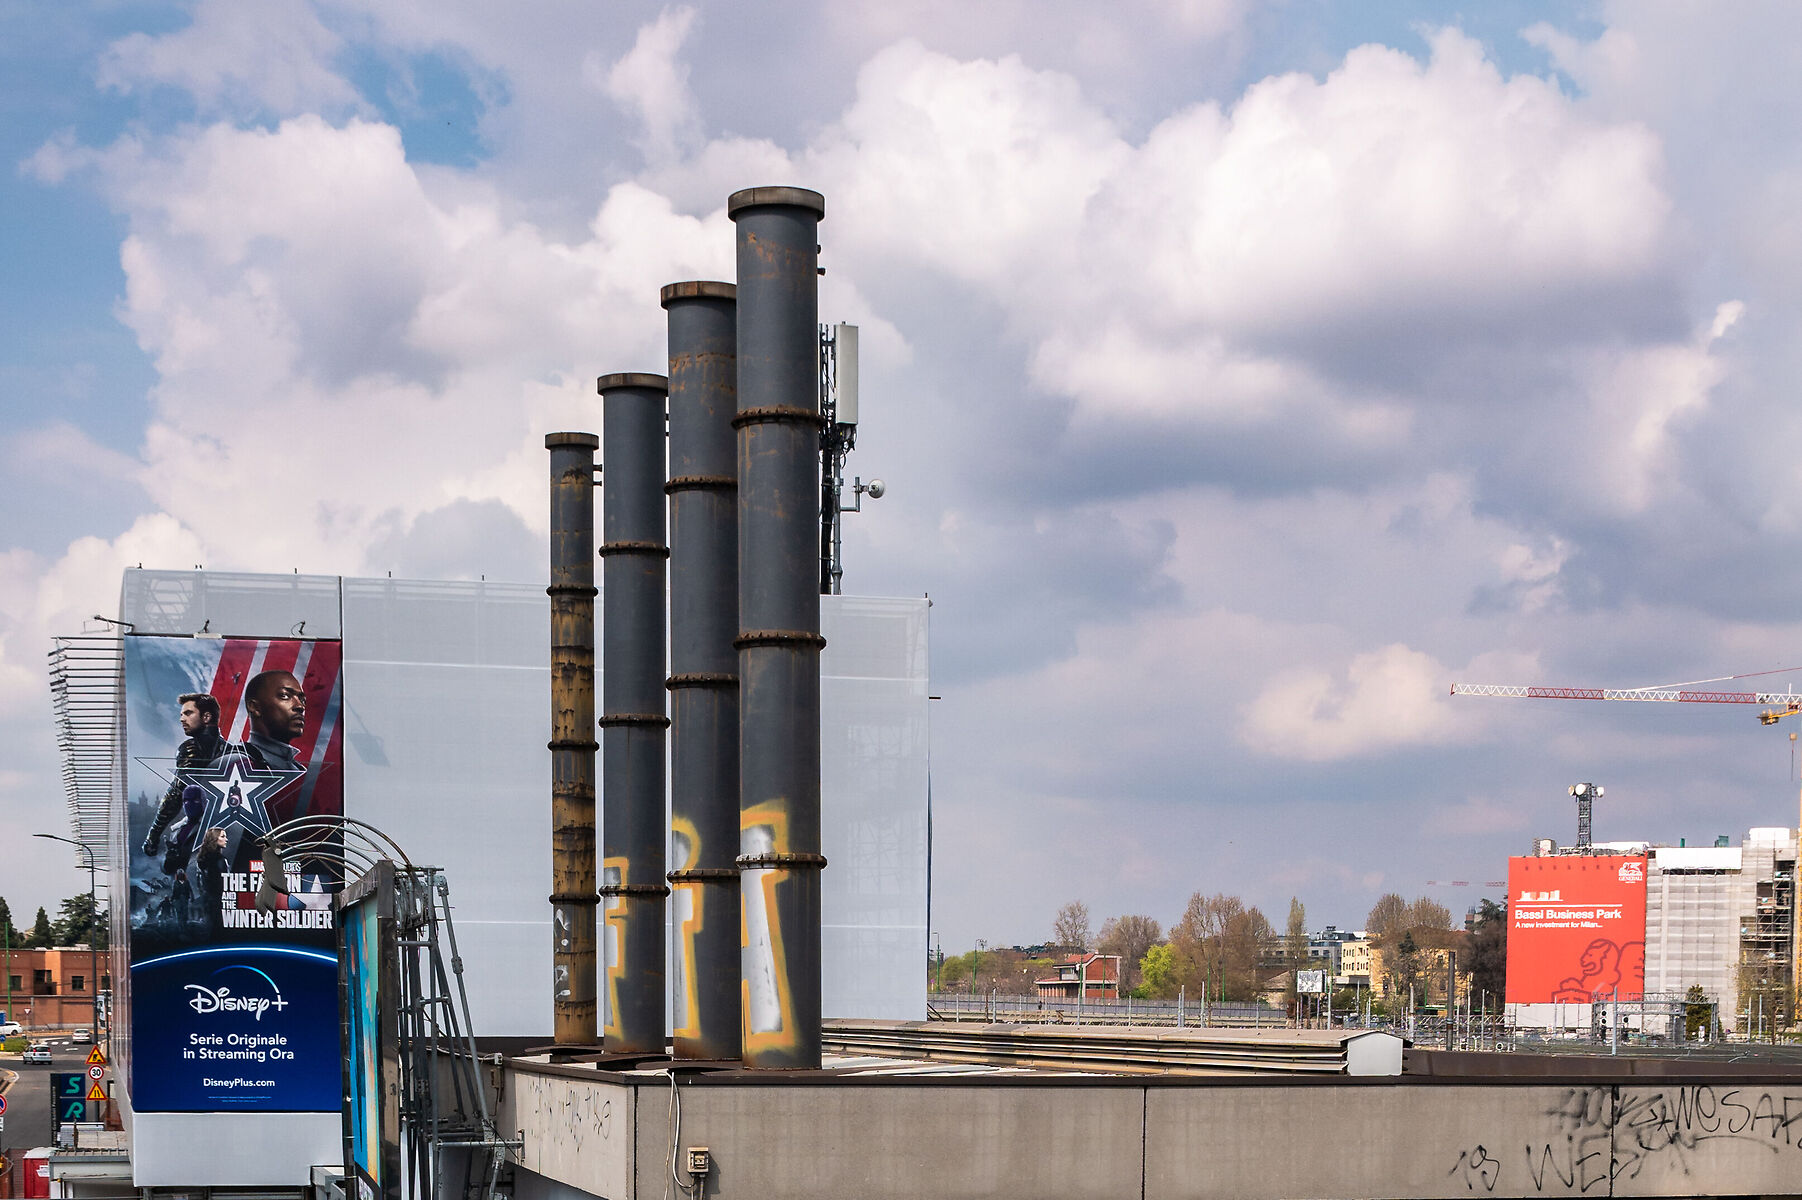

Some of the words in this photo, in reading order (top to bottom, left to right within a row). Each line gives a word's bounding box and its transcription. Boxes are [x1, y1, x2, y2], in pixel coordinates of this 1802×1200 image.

[221, 873, 247, 891] THE
[221, 892, 237, 900] AND
[221, 900, 237, 910] THE
[276, 910, 333, 929] SOLDIER
[1515, 910, 1544, 919] Bassi
[1546, 909, 1594, 919] Business
[1596, 909, 1622, 919] Park
[190, 1033, 224, 1045] Serie
[227, 1033, 288, 1049] Originale
[183, 1047, 196, 1059] in
[199, 1047, 266, 1063] Streaming
[269, 1048, 294, 1060] Ora
[92, 1069, 101, 1077] 30
[66, 1077, 81, 1094] S
[203, 1078, 276, 1089] DisneyPlus.com
[64, 1101, 85, 1119] R
